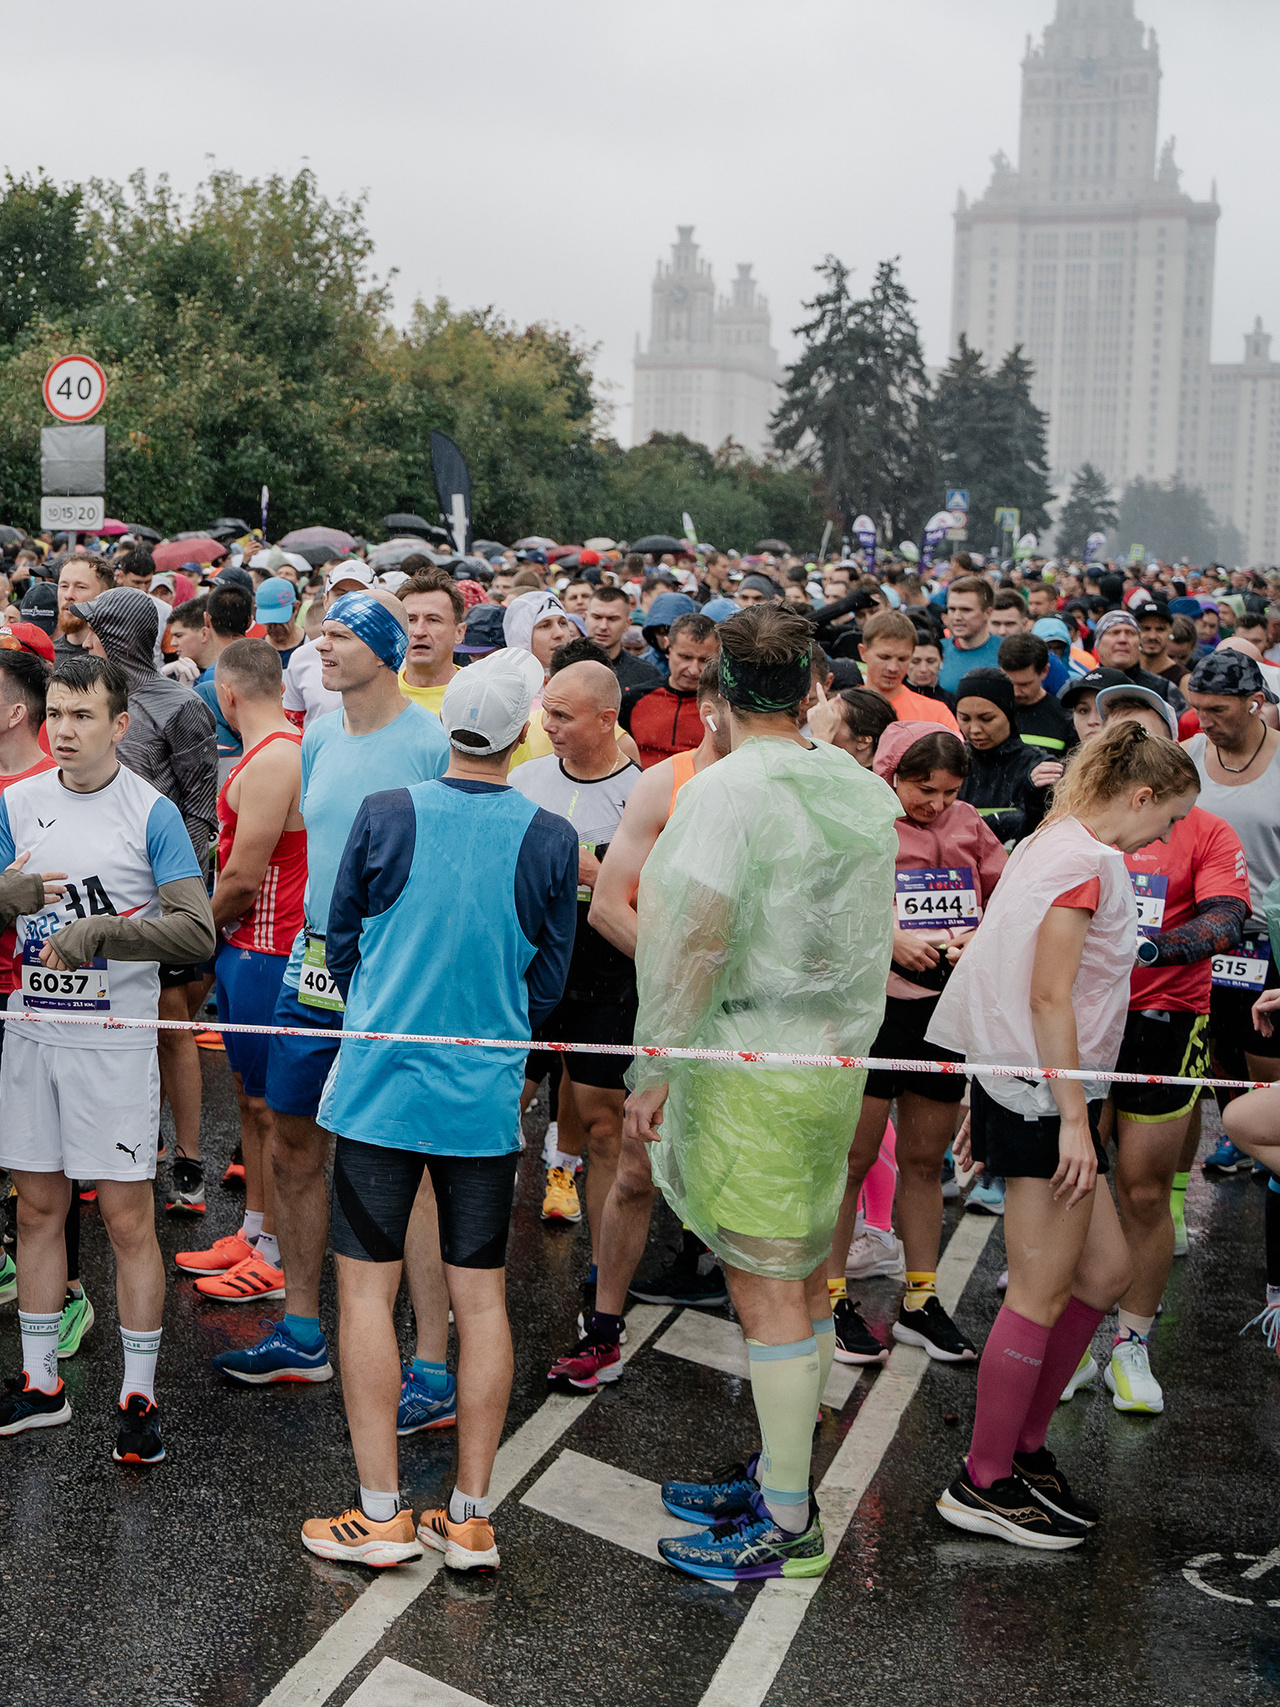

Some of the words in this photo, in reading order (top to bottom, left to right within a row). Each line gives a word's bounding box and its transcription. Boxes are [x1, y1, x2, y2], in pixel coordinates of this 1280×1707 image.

[56, 376, 92, 400] 40
[48, 508, 58, 517] 10
[62, 507, 73, 519] 15
[78, 507, 96, 520] 20
[904, 895, 963, 915] 6444
[1212, 959, 1248, 976] 615
[29, 972, 89, 995] 6037
[304, 971, 336, 994] 407
